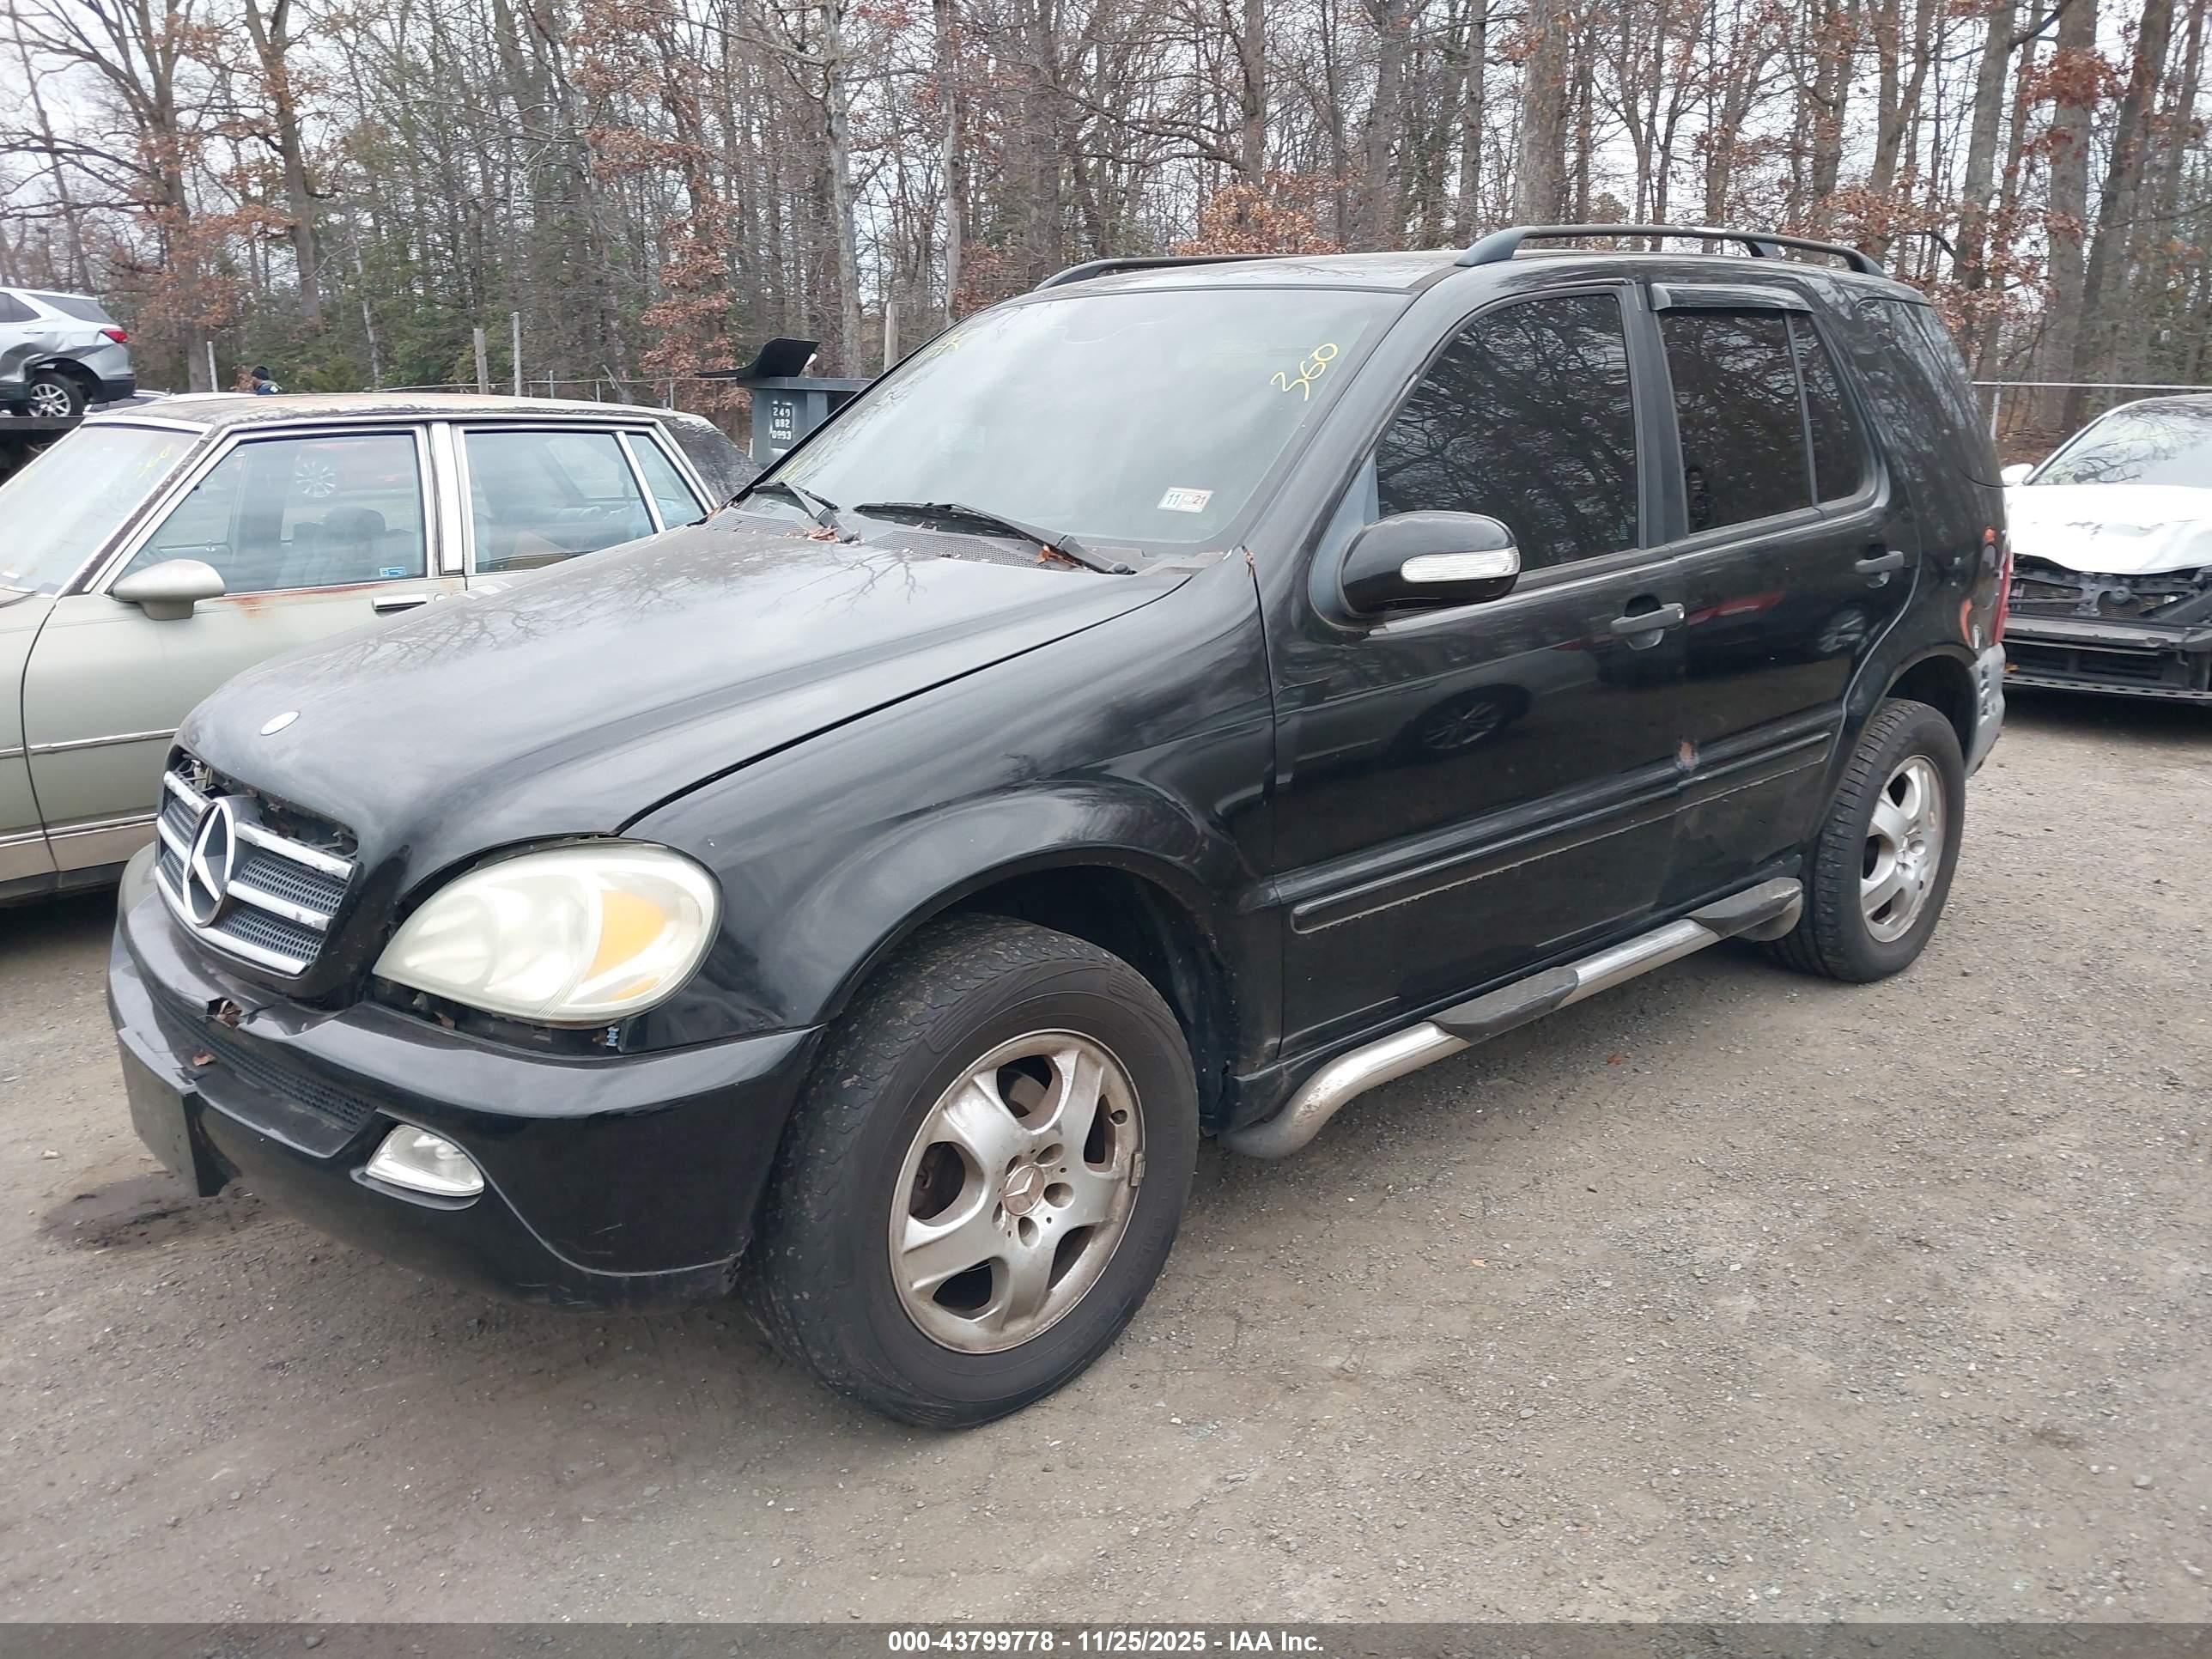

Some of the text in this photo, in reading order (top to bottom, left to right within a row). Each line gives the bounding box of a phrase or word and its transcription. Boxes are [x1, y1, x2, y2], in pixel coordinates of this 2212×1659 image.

[1269, 343, 1339, 402] 360
[1167, 493, 1182, 505] 11
[1192, 495, 1207, 505] 21
